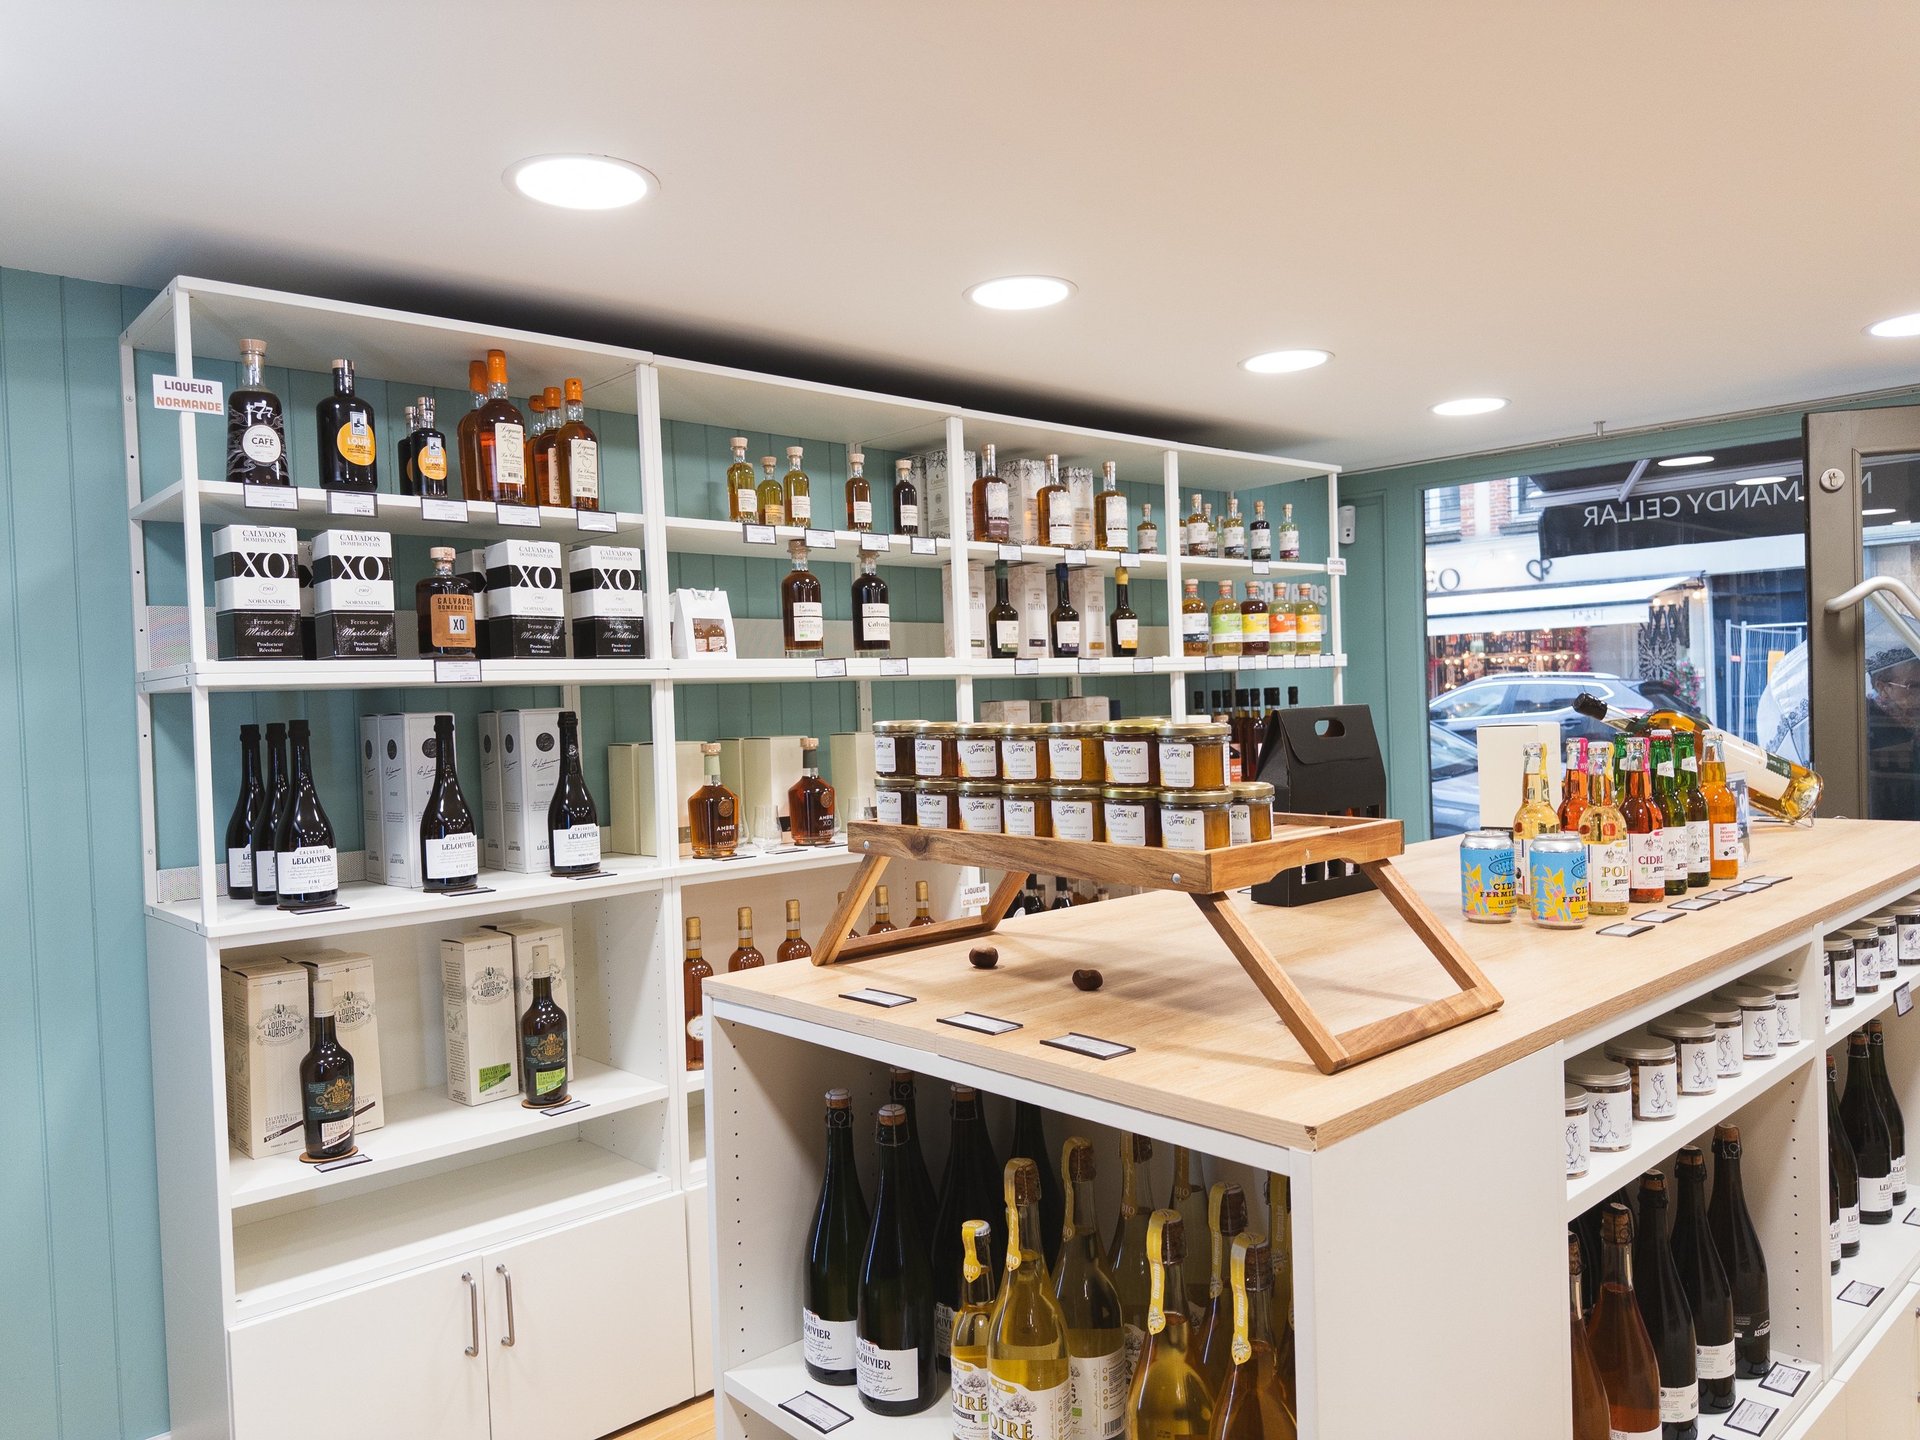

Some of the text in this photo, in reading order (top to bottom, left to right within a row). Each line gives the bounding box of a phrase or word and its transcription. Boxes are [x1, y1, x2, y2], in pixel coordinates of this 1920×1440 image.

[164, 380, 214, 395] LIQUEUR
[156, 396, 223, 412] NORMANDE
[242, 529, 286, 538] CALVADOS
[339, 534, 381, 542] CALVADOS
[518, 546, 554, 555] CALVADOS
[600, 549, 633, 557] CALVADOS
[240, 551, 290, 579] XO
[338, 554, 384, 581] XO
[515, 565, 557, 589] XO
[598, 568, 636, 591] XO
[453, 617, 465, 631] XO
[568, 831, 599, 840] LELOUVIER
[441, 841, 476, 851] LELOUVIER
[292, 854, 332, 866] LELOUVIER
[965, 886, 986, 895] LIQUEUR
[477, 986, 504, 997] LAURISTON
[480, 981, 496, 991] LOUIS
[338, 1006, 356, 1016] LOUIS
[267, 1020, 288, 1031] LOUIS
[264, 1025, 298, 1038] LAURISTON
[964, 1264, 979, 1275] BIO
[804, 1322, 832, 1341] OUVIER
[952, 1389, 989, 1413] OIRÉ
[990, 1410, 1034, 1440] OIRÉ
